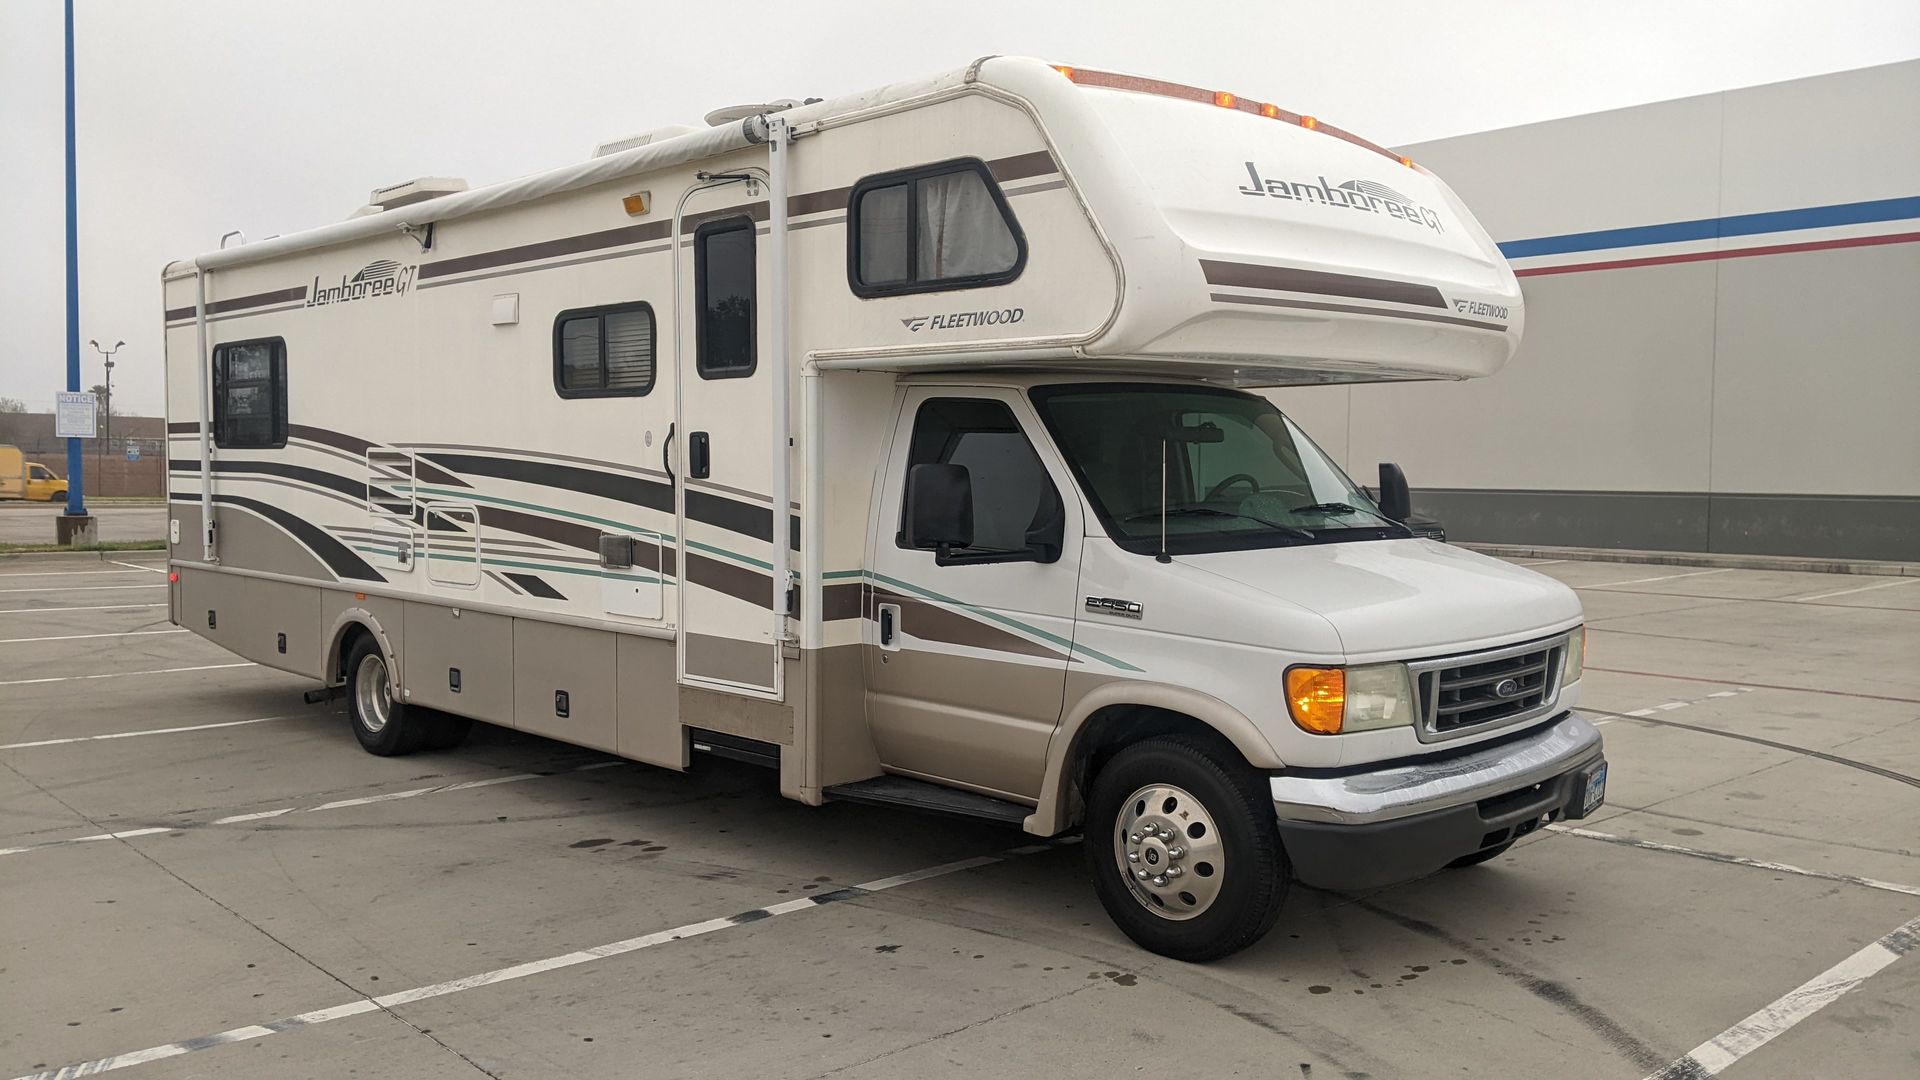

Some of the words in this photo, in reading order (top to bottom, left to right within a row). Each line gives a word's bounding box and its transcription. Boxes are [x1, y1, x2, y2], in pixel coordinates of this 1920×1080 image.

[1238, 161, 1423, 226] Jamboree
[1419, 206, 1445, 234] GT
[306, 274, 395, 308] Jamboree
[395, 265, 417, 297] GT
[930, 308, 1024, 330] FLEETWOOD
[1468, 301, 1509, 319] FLEETWOOD
[58, 394, 93, 403] NOTICE
